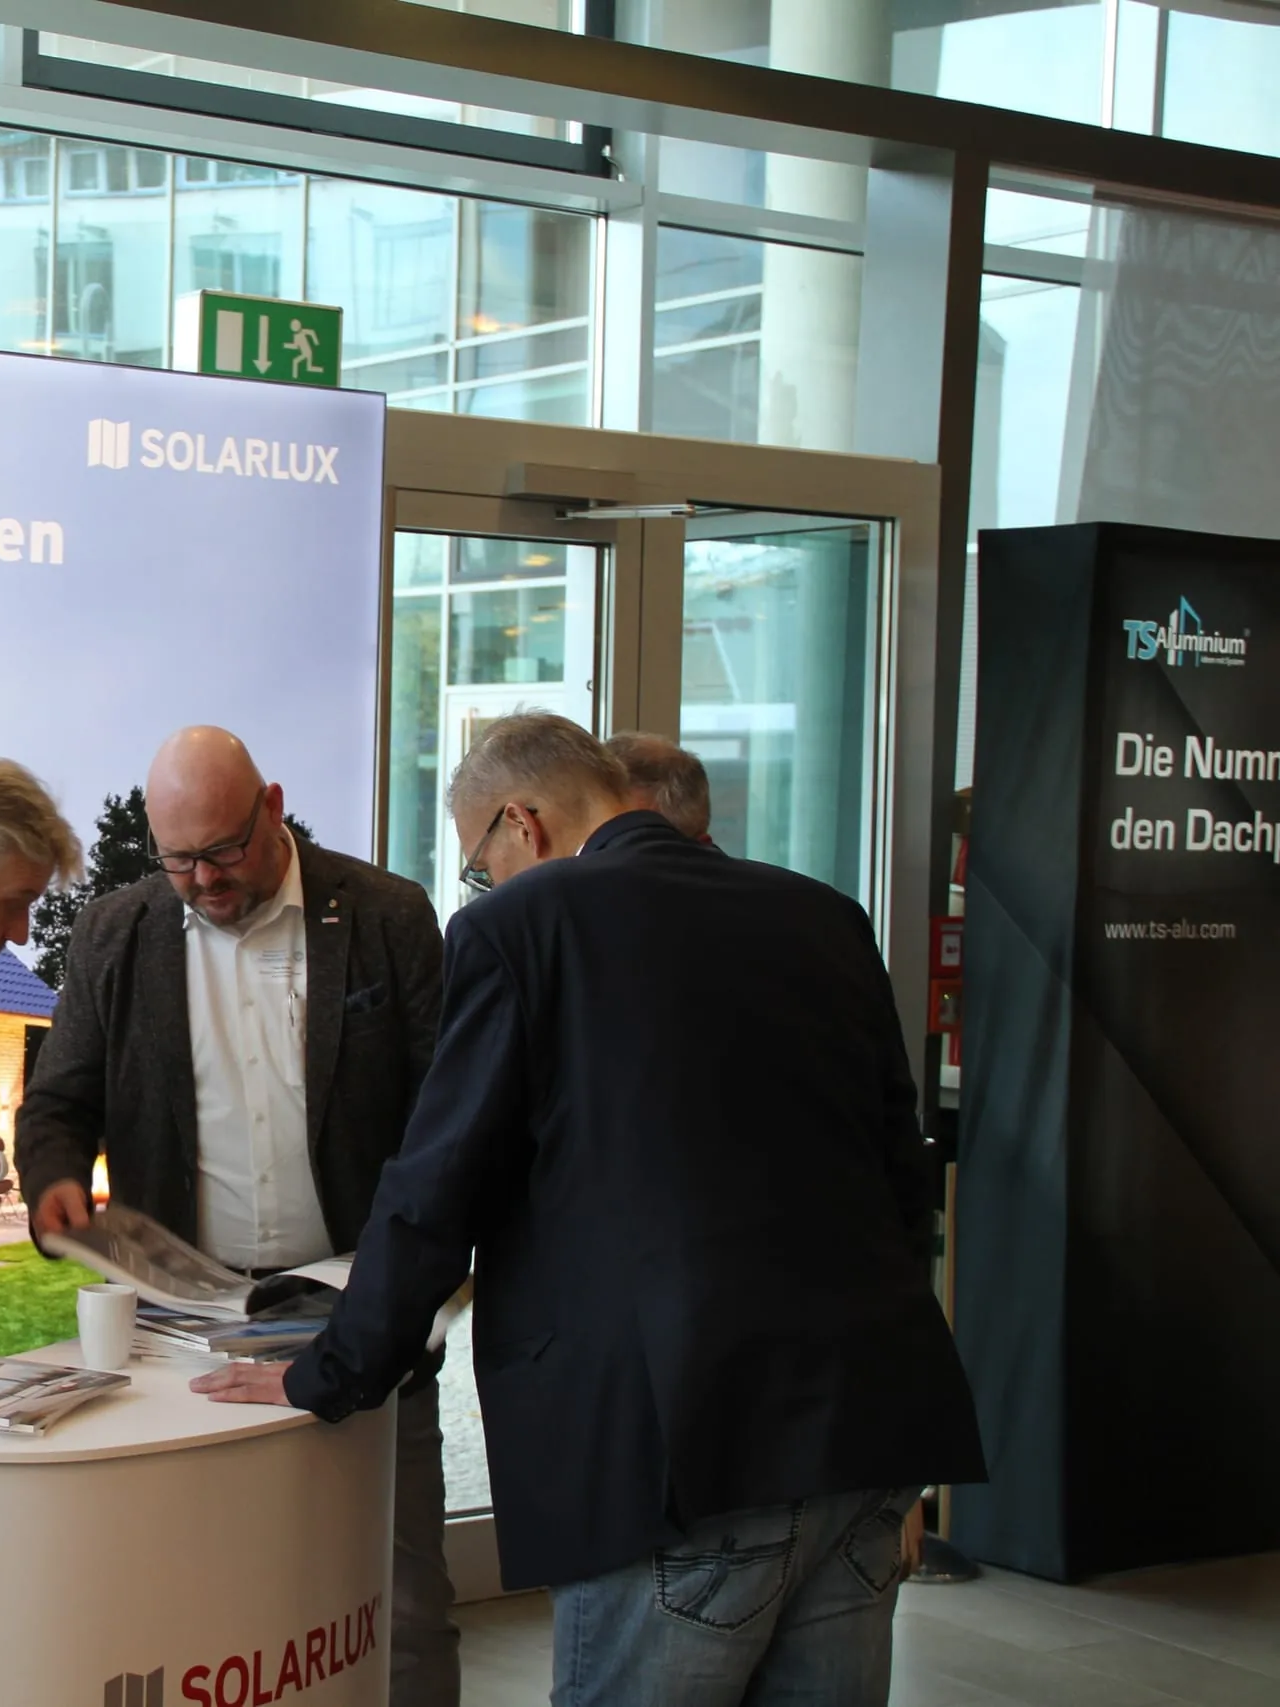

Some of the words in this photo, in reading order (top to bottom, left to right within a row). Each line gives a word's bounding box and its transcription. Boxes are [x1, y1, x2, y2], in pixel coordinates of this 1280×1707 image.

[140, 428, 339, 485] SOLARLUX
[1115, 732, 1174, 778] Die
[1110, 806, 1176, 851] den
[1185, 808, 1280, 865] Dach
[1104, 917, 1237, 940] www.ts-alu.com
[181, 1595, 377, 1707] SOLARLUX
